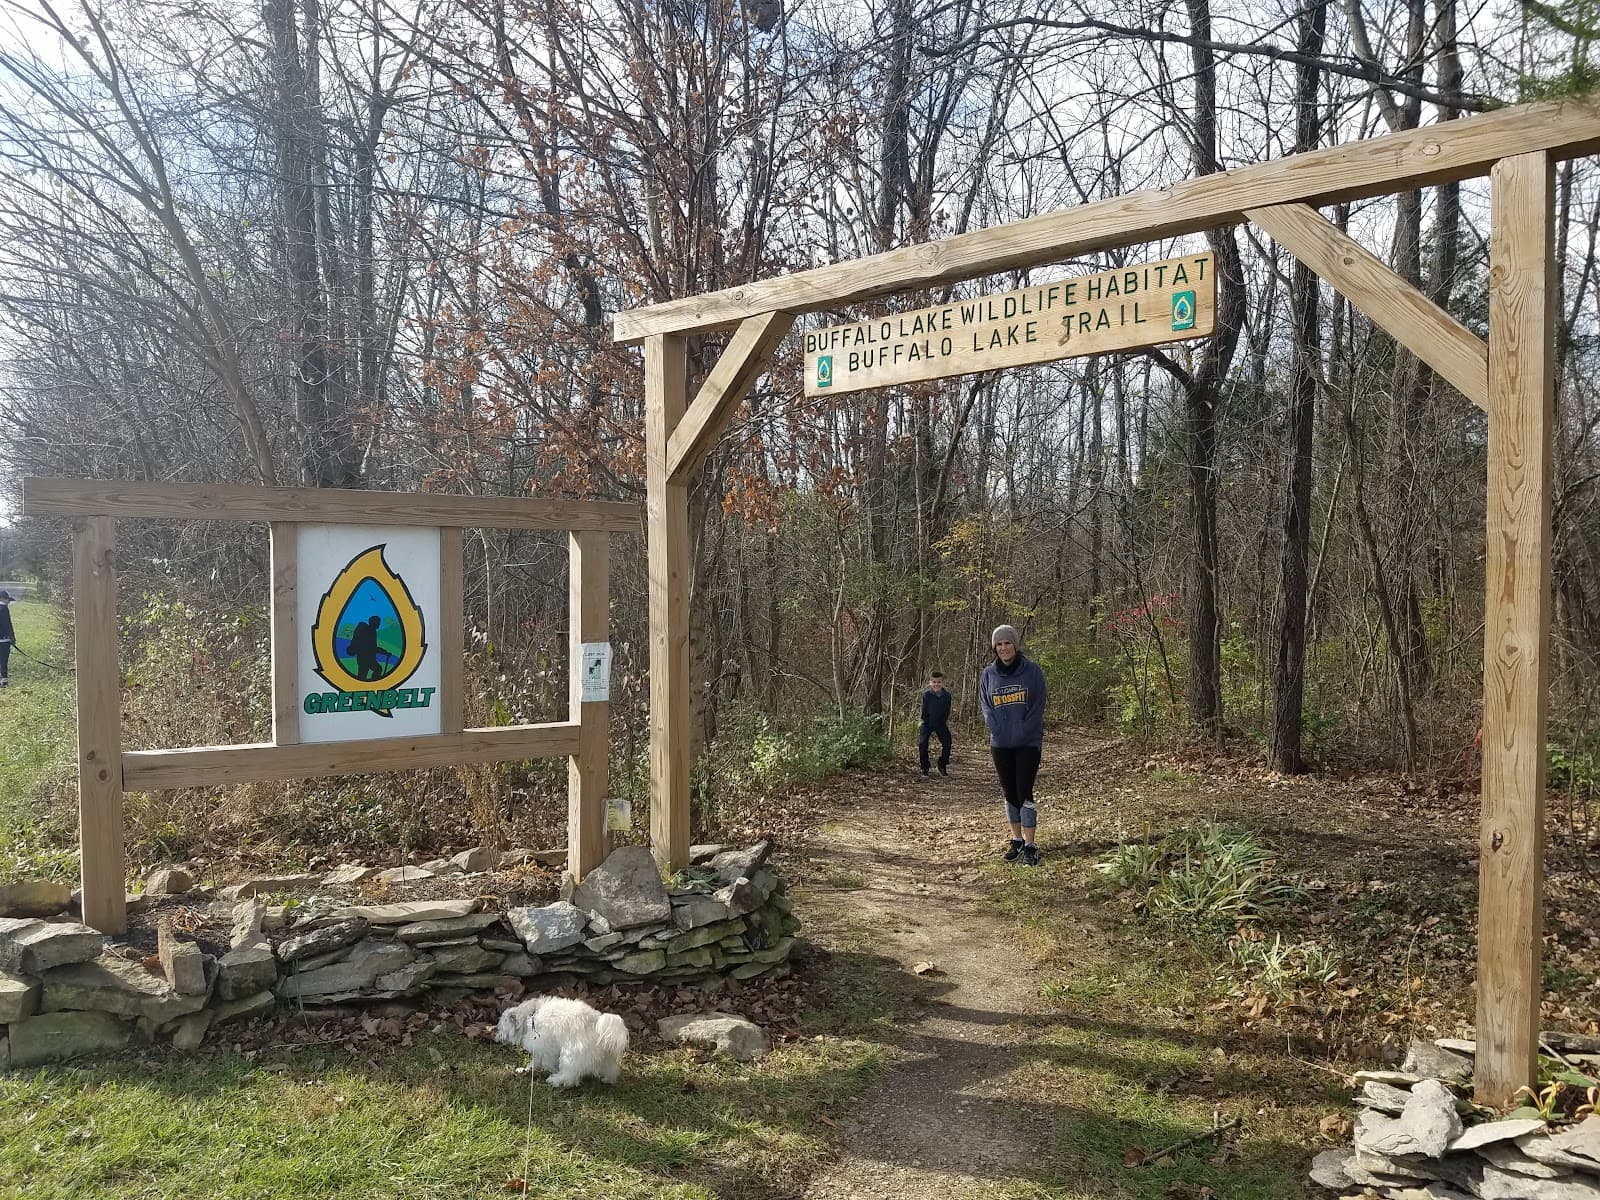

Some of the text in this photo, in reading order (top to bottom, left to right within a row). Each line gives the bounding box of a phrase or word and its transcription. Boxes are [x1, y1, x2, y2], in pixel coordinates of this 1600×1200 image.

[807, 258, 1208, 353] BUFFALO LAKE WILDLIFE HABITAT
[849, 302, 1146, 372] BUFFALO LAKE TRAIL
[303, 687, 436, 715] GREENBELT
